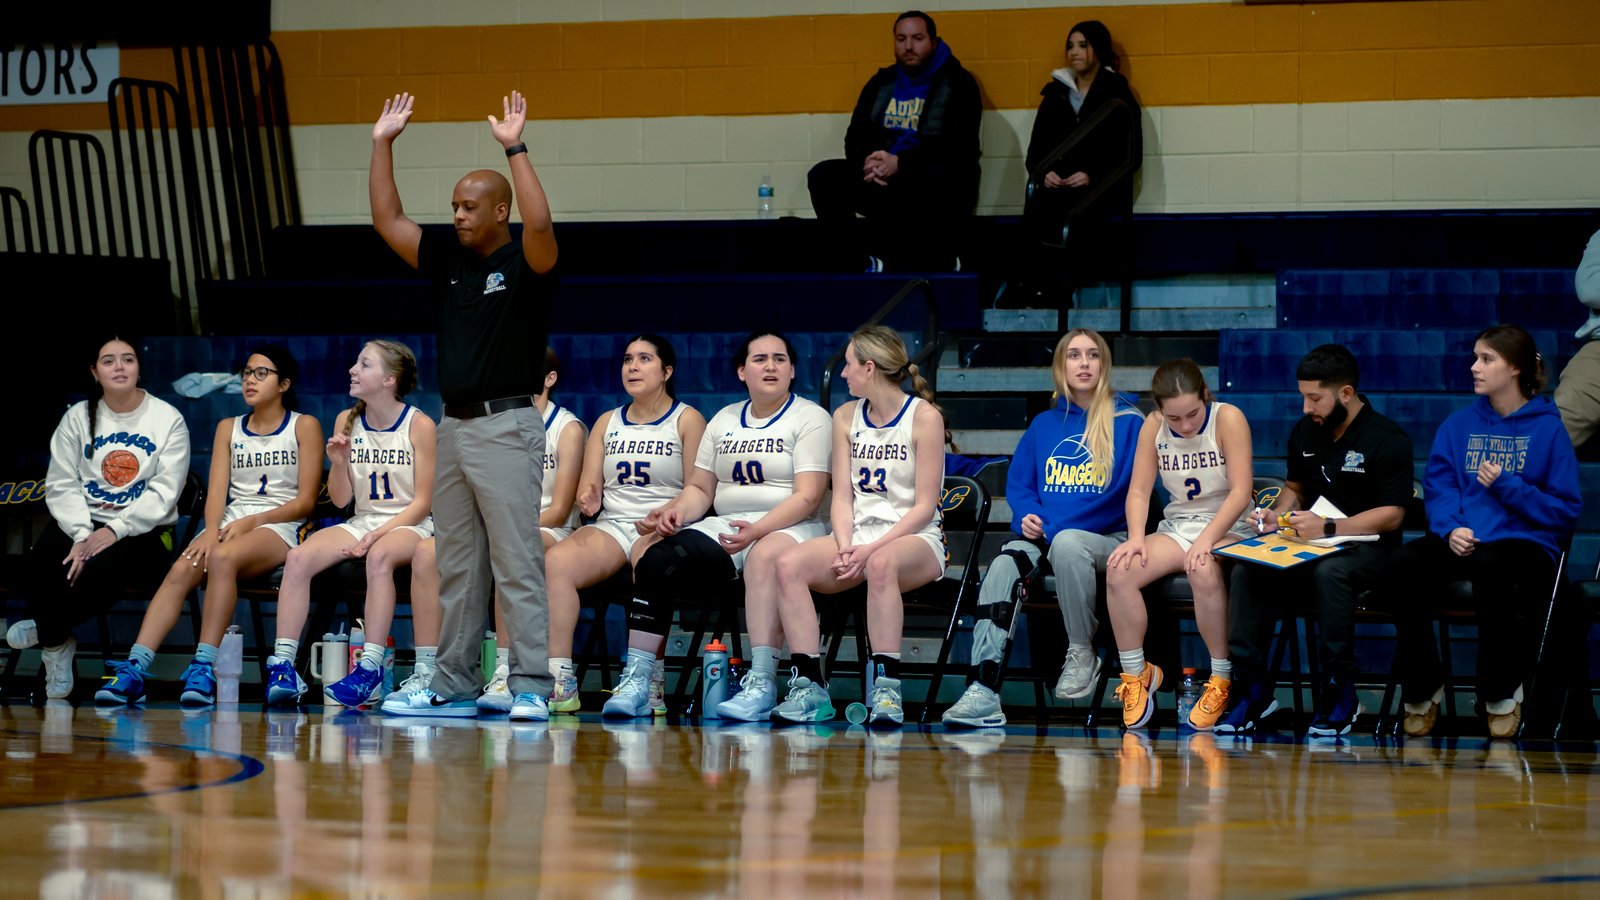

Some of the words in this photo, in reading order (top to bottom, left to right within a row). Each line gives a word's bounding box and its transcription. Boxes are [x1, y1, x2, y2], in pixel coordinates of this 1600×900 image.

[349, 448, 411, 465] CHARGERS
[605, 440, 675, 457] CHARGERS
[718, 438, 784, 455] CHARGERS
[851, 442, 908, 461] HARGERS
[616, 461, 651, 487] 25
[732, 460, 766, 485] 40
[858, 467, 888, 493] 23
[256, 473, 269, 496] 1
[368, 471, 394, 500] 11
[1043, 485, 1103, 494] BASKETBALL
[1184, 477, 1202, 501] 2
